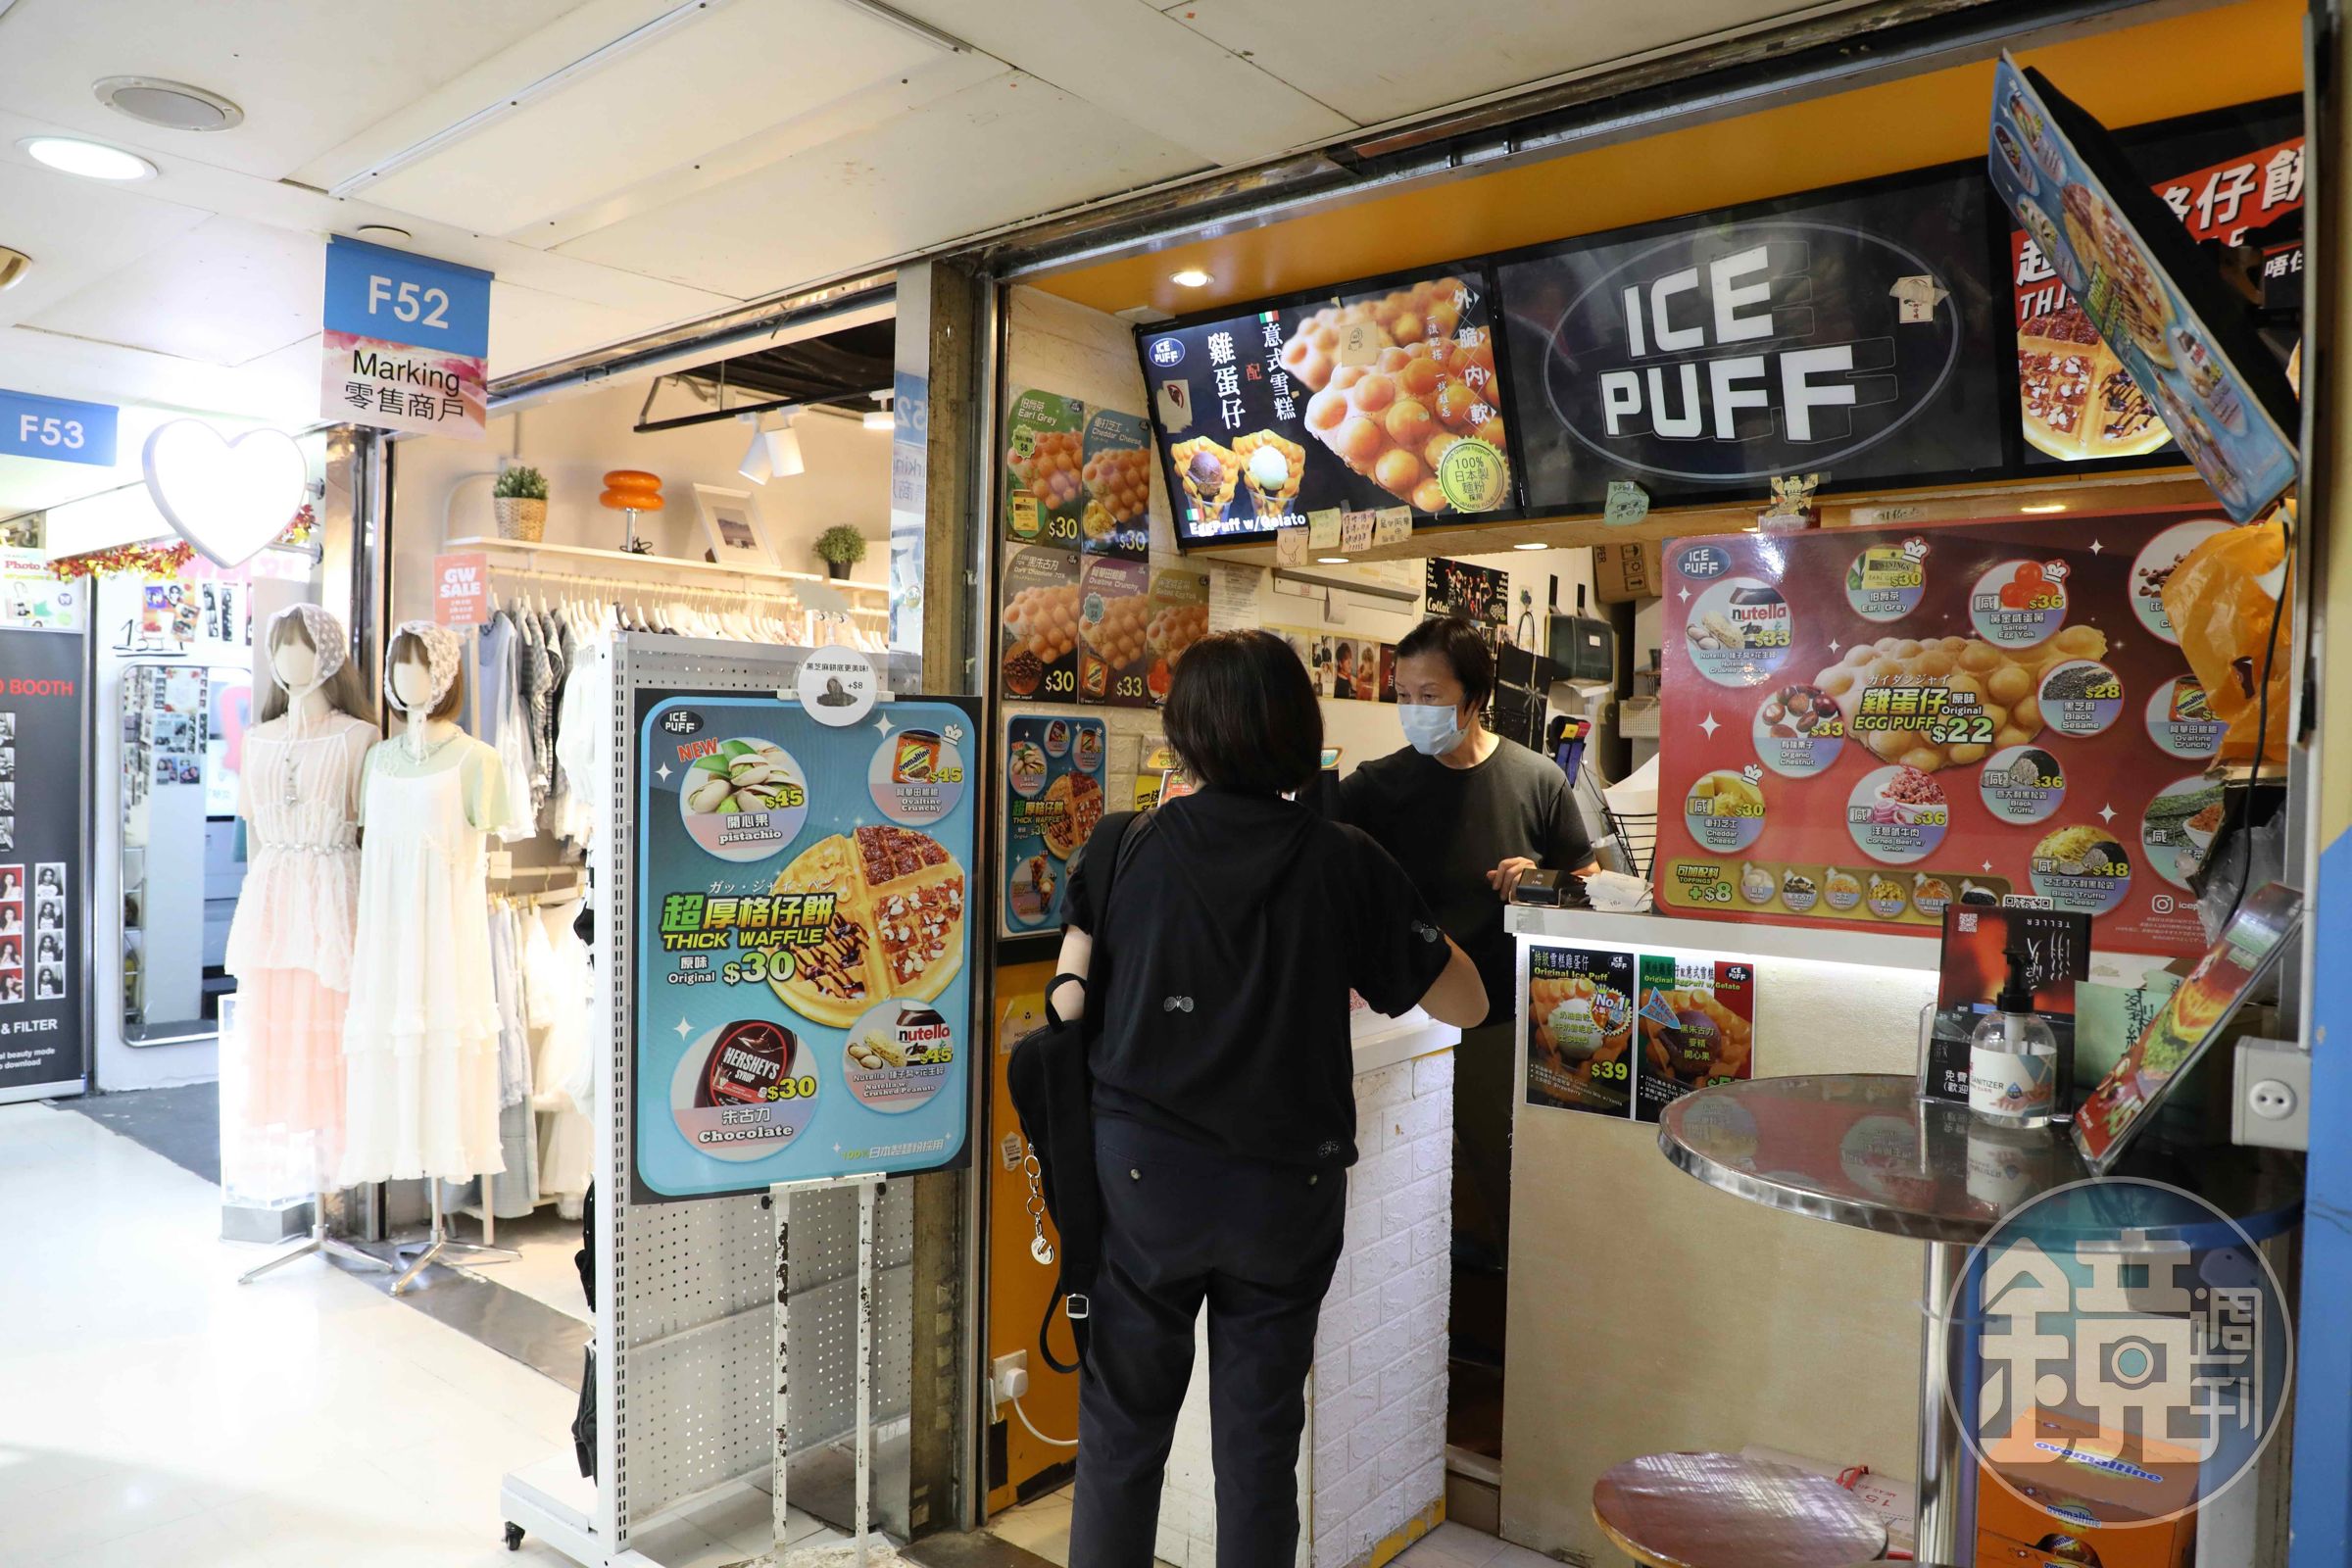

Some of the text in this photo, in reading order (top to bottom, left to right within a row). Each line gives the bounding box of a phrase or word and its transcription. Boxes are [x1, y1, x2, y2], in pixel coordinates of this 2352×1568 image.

[368, 275, 449, 329] F52
[1624, 246, 1775, 357] ICE
[2020, 284, 2068, 320] THI
[1155, 340, 1171, 353] ICE
[1154, 349, 1179, 364] PUFF
[352, 350, 461, 397] Marking
[1246, 363, 1262, 381] 配
[1262, 322, 1296, 420] 意式雪糕
[1208, 331, 1246, 430] 雞蛋仔
[344, 380, 465, 421] 零售商戶
[1600, 345, 1856, 441] PUFF
[1018, 408, 1057, 426] Earl Grey
[20, 416, 85, 450] F53
[1455, 456, 1483, 469] 100%
[1049, 516, 1078, 539] $30
[1189, 518, 1241, 537] EggPuff
[1119, 530, 1146, 551] $30
[5, 560, 40, 571] Photo
[1689, 552, 1709, 563] ICE
[444, 566, 476, 584] GW
[1685, 562, 1719, 574] PUFF
[1890, 572, 1923, 587] $30
[439, 581, 481, 599] SALE
[1862, 604, 1907, 612] Earl Grey
[2029, 594, 2063, 610] $36
[1732, 604, 1787, 621] nutella
[1754, 630, 1790, 647] $33
[10, 679, 74, 697] BOOTH
[848, 681, 863, 690] +$8
[1046, 669, 1074, 692] $30
[1116, 676, 1143, 698] $33
[1952, 693, 1976, 705] 原味
[2085, 685, 2121, 700] $28
[1861, 688, 1948, 714] 雞蛋仔
[669, 711, 688, 722] ICE
[1941, 706, 1982, 717] Original
[2065, 712, 2092, 721] Black
[665, 721, 695, 734] PUFF
[1810, 722, 1843, 736] $33
[1854, 716, 1937, 730] EGG PUFF
[1931, 716, 1993, 744] $22
[2061, 721, 2100, 730] Sesame
[677, 738, 718, 762] NEW
[2174, 741, 2212, 750] Crunchy
[1781, 751, 1810, 760] Organic
[930, 767, 963, 783] $45
[2034, 775, 2063, 789] $36
[764, 789, 805, 808] $45
[1735, 805, 1764, 817] $30
[1914, 810, 1946, 825] $36
[726, 813, 769, 831] 開心果
[718, 829, 782, 845] pistachio
[1706, 829, 1738, 838] Cheddar
[2092, 862, 2129, 877] $48
[2079, 891, 2106, 900] Truffle
[662, 894, 835, 932] 超厚格仔餅
[663, 928, 824, 950] THICK WAFFLE
[680, 956, 709, 970] 原味
[722, 951, 796, 985] $30
[668, 972, 715, 987] Original
[1534, 967, 1569, 978] Original
[1589, 972, 1608, 981] Puff
[1644, 975, 1673, 984] Original
[1, 1018, 58, 1035] & FILTER
[899, 1024, 951, 1042] nutella
[7, 1048, 55, 1059] beauty mode
[919, 1047, 953, 1064] $45
[5, 1058, 41, 1069] download
[723, 1047, 780, 1080] HERSHEY'S
[1592, 1060, 1628, 1081] $39
[735, 1069, 756, 1083] SYRUP
[853, 1071, 885, 1082] Nutella
[1944, 1069, 1968, 1084] 免費
[767, 1076, 815, 1101] $30
[863, 1085, 936, 1098] Crushed Peanuts
[864, 1082, 896, 1091] Nutella
[722, 1107, 770, 1125] 朱古力
[699, 1125, 793, 1143] Chocolate
[2034, 1442, 2163, 1484] ovomaltine
[2046, 1505, 2101, 1529] ovomaltine
